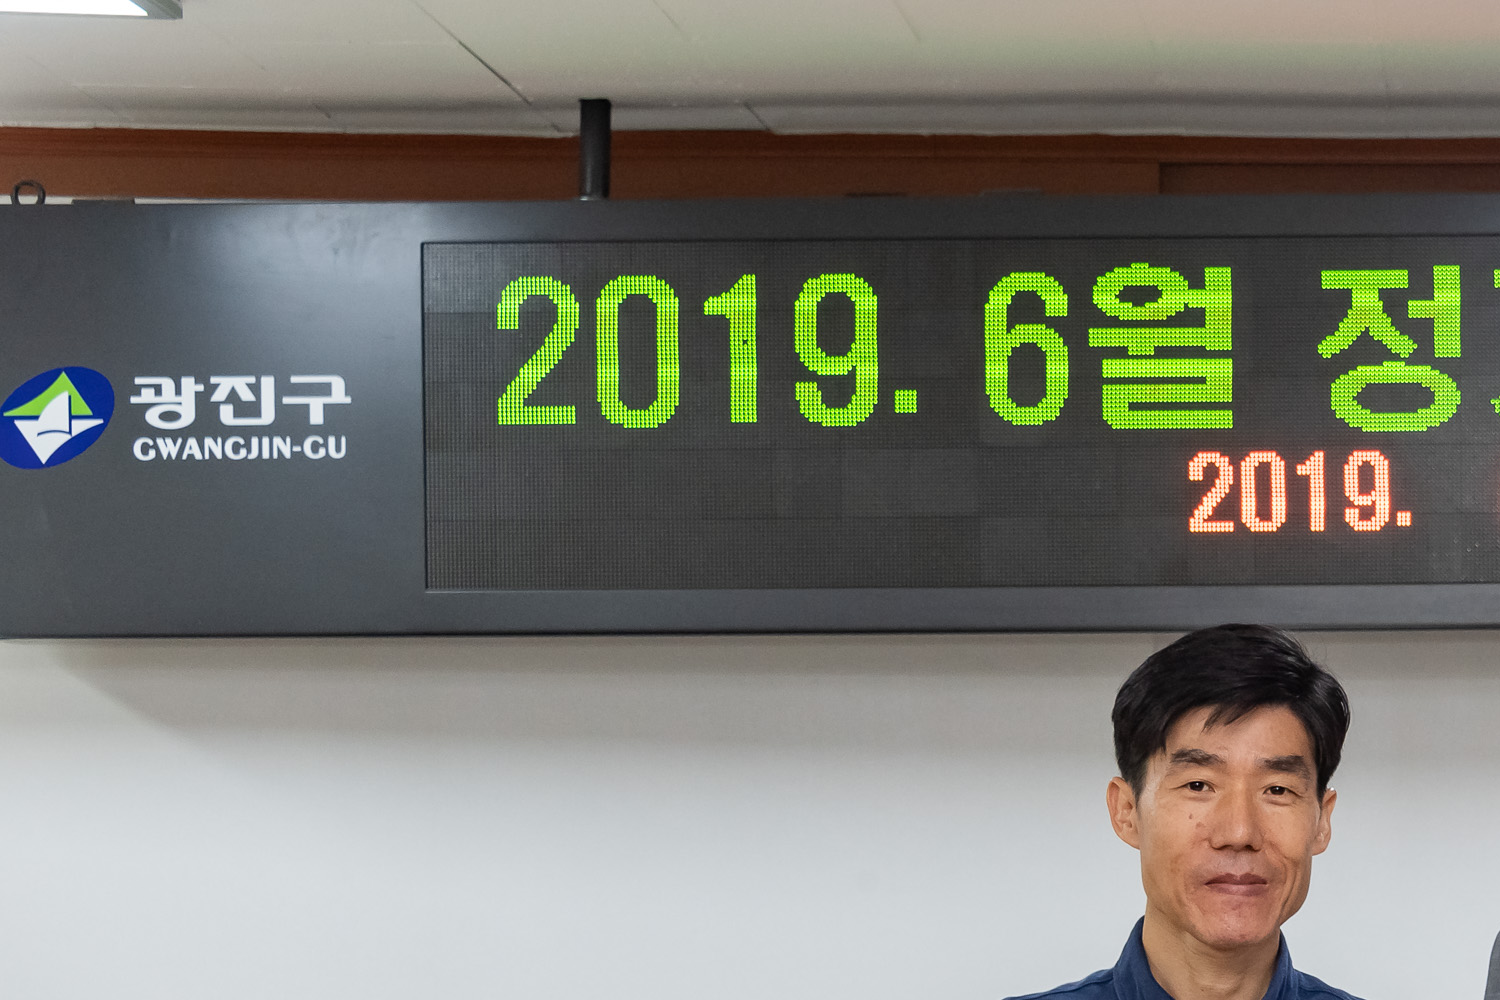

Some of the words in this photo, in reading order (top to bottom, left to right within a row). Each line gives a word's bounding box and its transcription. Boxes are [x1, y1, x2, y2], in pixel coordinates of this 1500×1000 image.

[497, 273, 917, 428] 2019.
[985, 263, 1233, 429] 6월
[129, 374, 352, 429] 광진구
[133, 435, 347, 461] GWANGJIN-GU
[1188, 450, 1412, 532] 2019.
